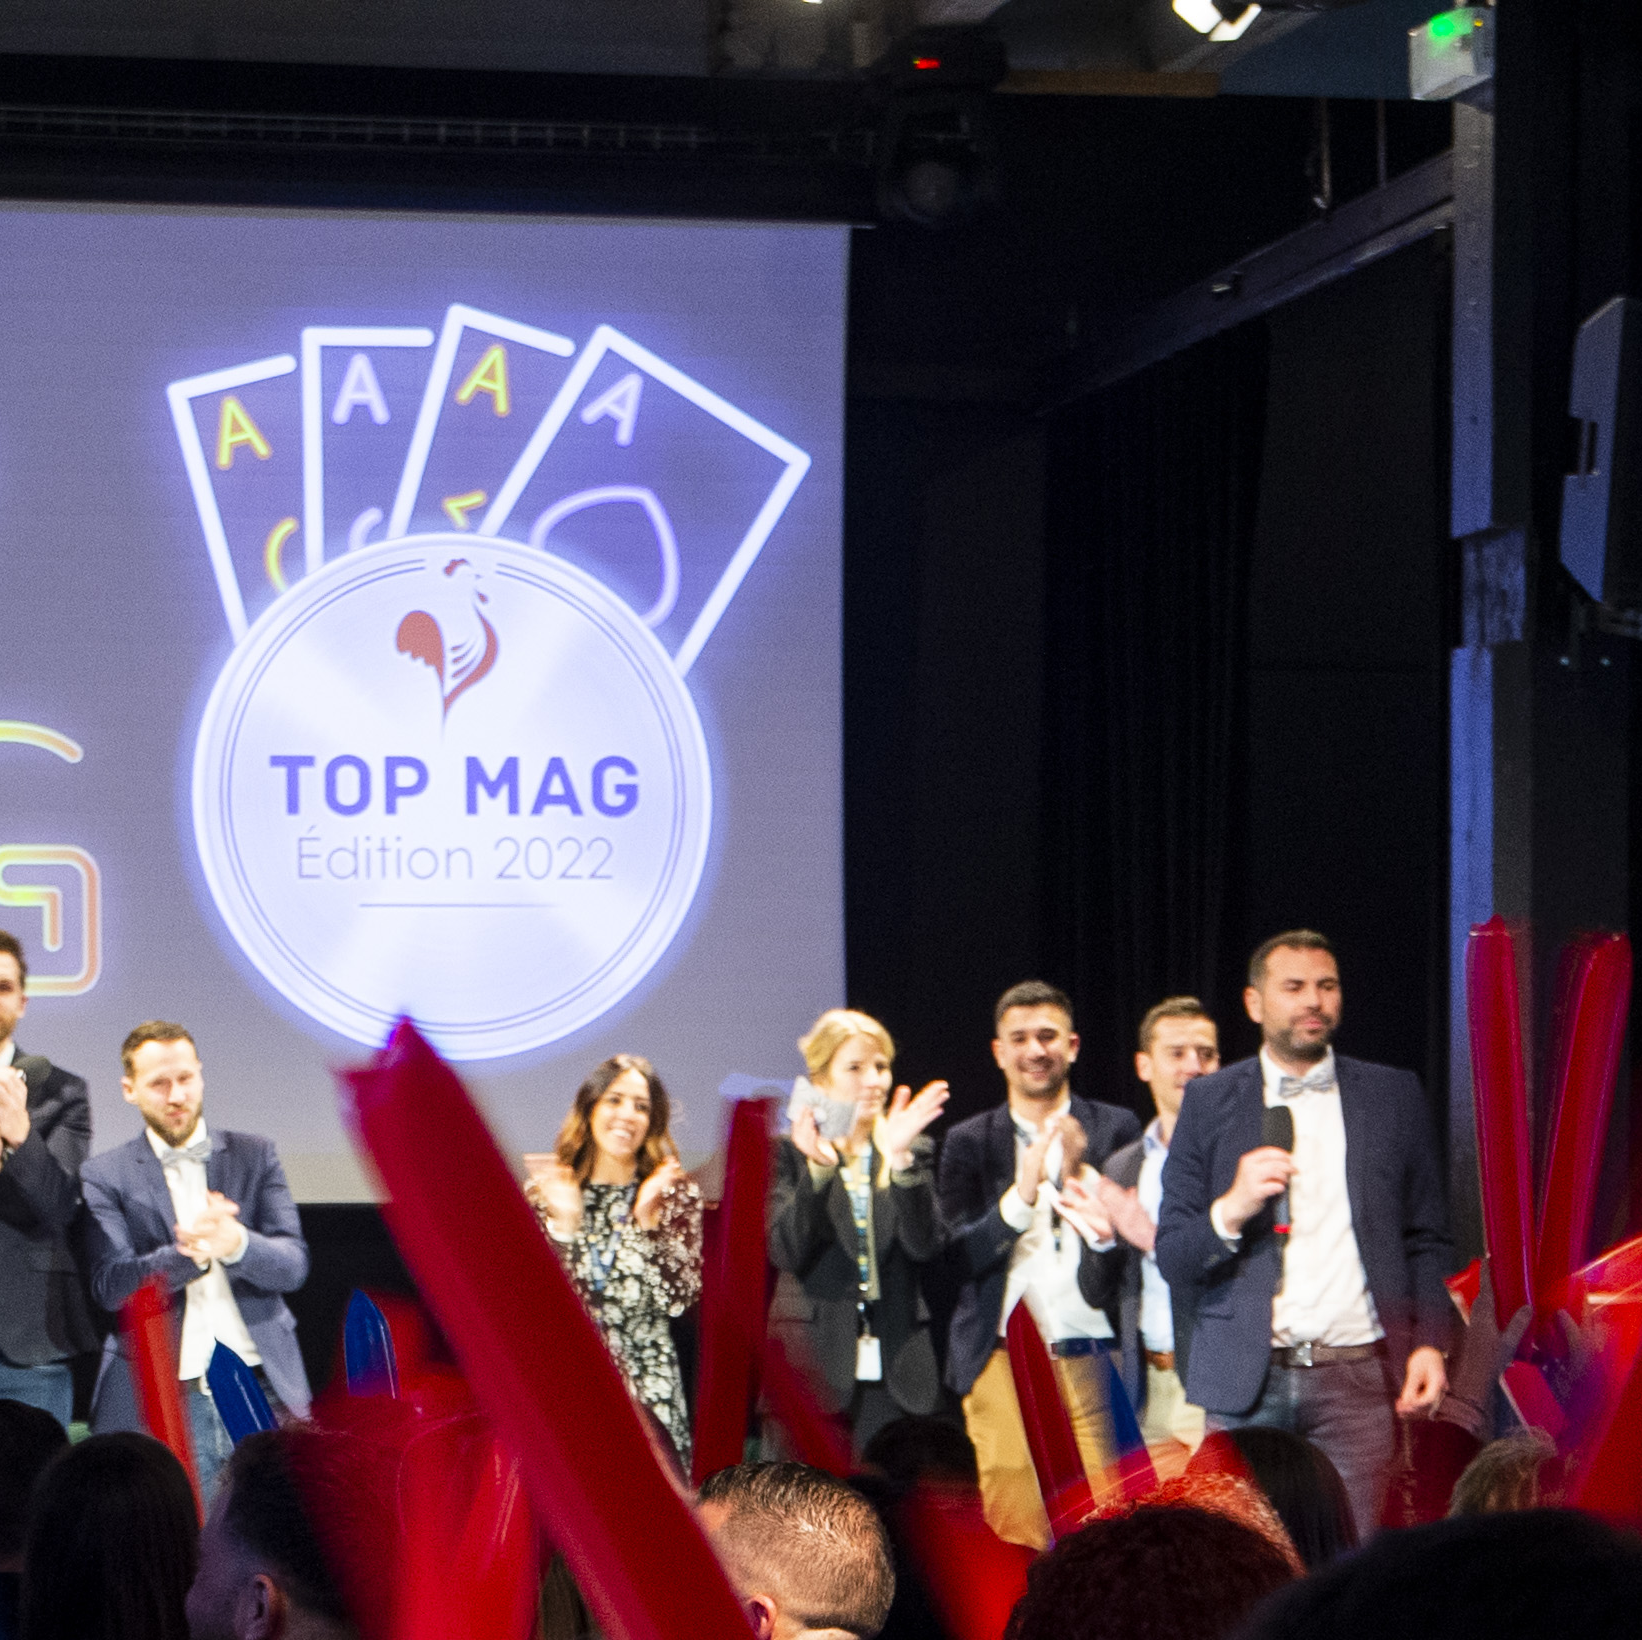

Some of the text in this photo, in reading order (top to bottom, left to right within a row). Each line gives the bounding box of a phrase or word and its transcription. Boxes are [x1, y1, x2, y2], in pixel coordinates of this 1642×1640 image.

[331, 353, 391, 426] A
[455, 345, 512, 416] A
[580, 373, 644, 447] A
[216, 398, 271, 469] A
[268, 753, 642, 818] TOP MAG
[296, 826, 615, 882] Édition 2022
